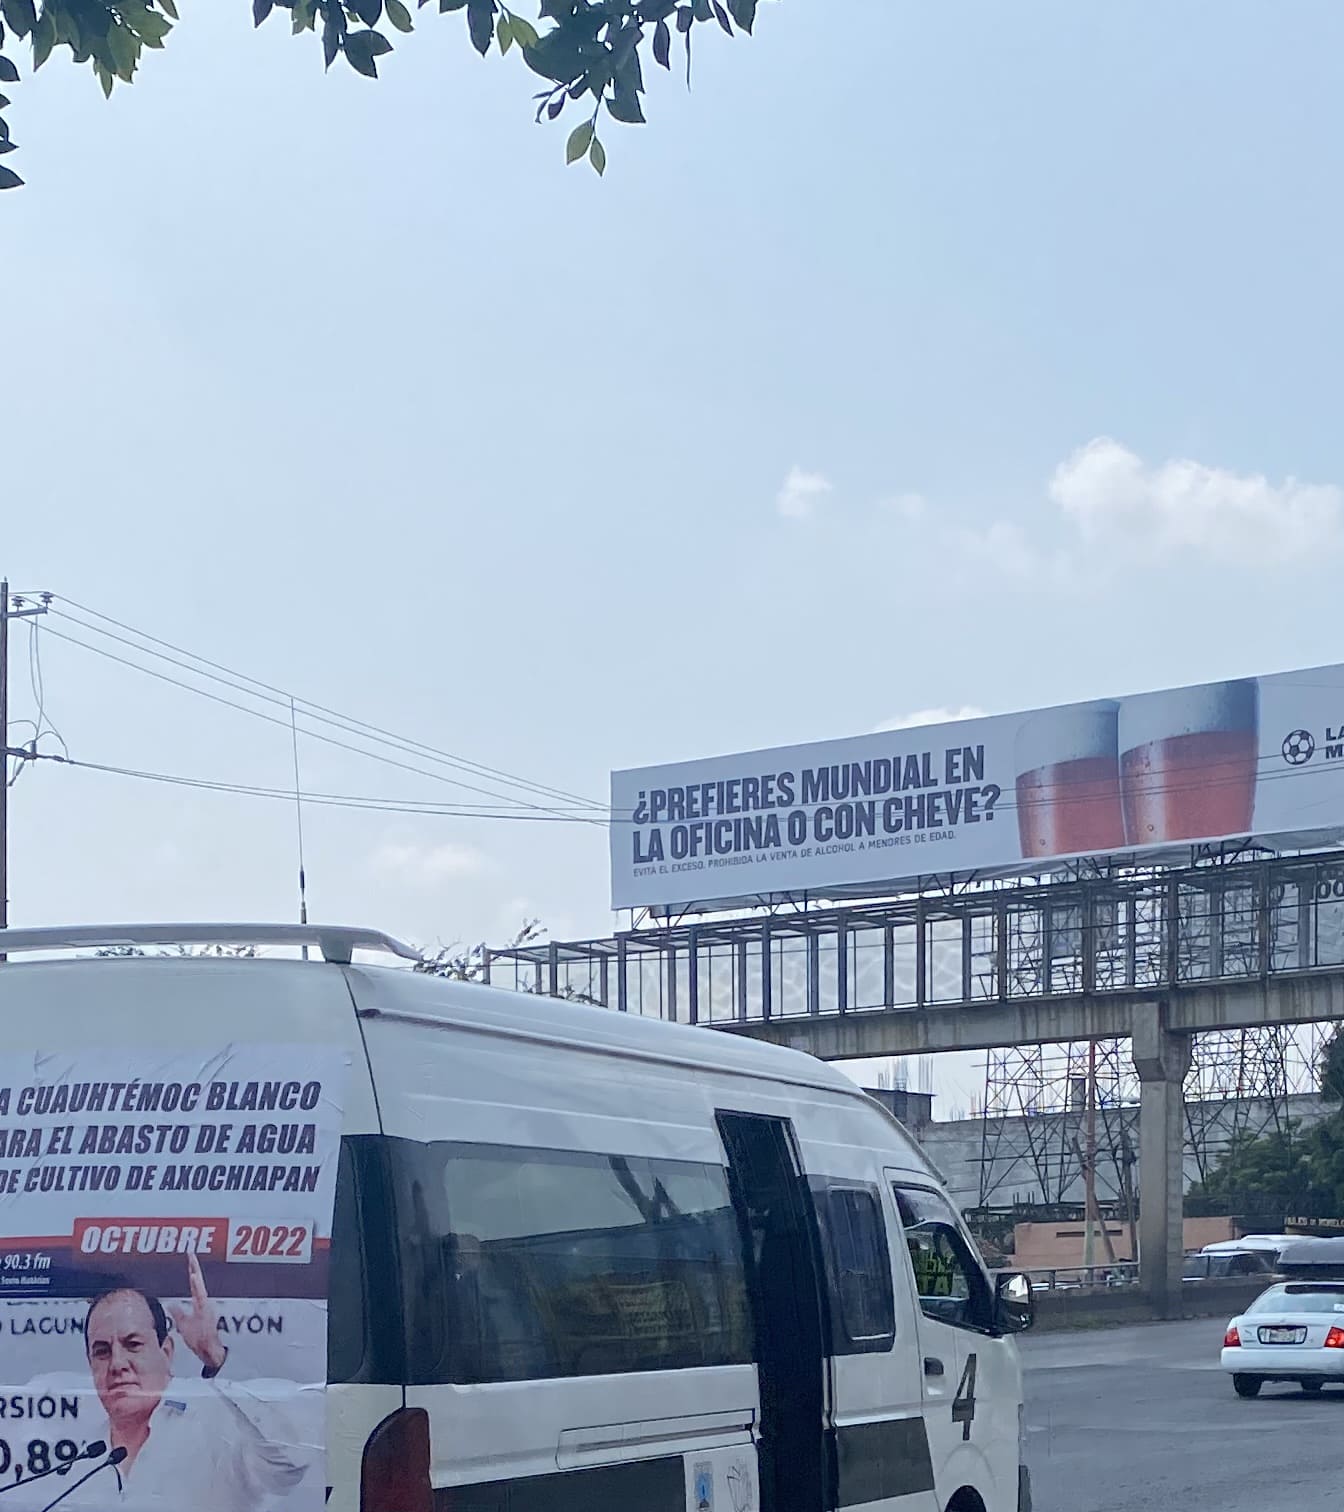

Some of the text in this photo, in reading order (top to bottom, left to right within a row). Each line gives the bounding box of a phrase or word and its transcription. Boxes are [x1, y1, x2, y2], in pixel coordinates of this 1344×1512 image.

[632, 745, 985, 825] ¿PREFIERES MUNDIAL EN
[632, 783, 1001, 864] LA OFICINA O CON CHEVE?
[632, 867, 657, 878] EVITA
[659, 865, 669, 874] EL
[708, 856, 753, 869] PROHIBIDA
[756, 853, 768, 863] LA
[770, 850, 798, 862] VENTA
[801, 848, 813, 858] DE
[815, 844, 856, 856] ALCOHOL
[858, 842, 866, 851] A
[867, 837, 912, 851] MENORES
[914, 835, 927, 845] DE
[16, 1077, 202, 1116] CUAUHTÉMOC
[205, 1081, 322, 1112] BLANCO
[46, 1125, 74, 1155] EL
[78, 1124, 190, 1155] ABASTO
[194, 1124, 233, 1153] DE
[234, 1124, 316, 1154] AGUA
[23, 1165, 122, 1193] CULTIVO
[124, 1165, 157, 1191] DE
[158, 1165, 320, 1193] AXOCHIAPAN
[80, 1226, 307, 1256] OCTUBRE 2022
[4, 1253, 30, 1271] 90.3
[32, 1252, 51, 1271] fm
[952, 1352, 978, 1442] 4
